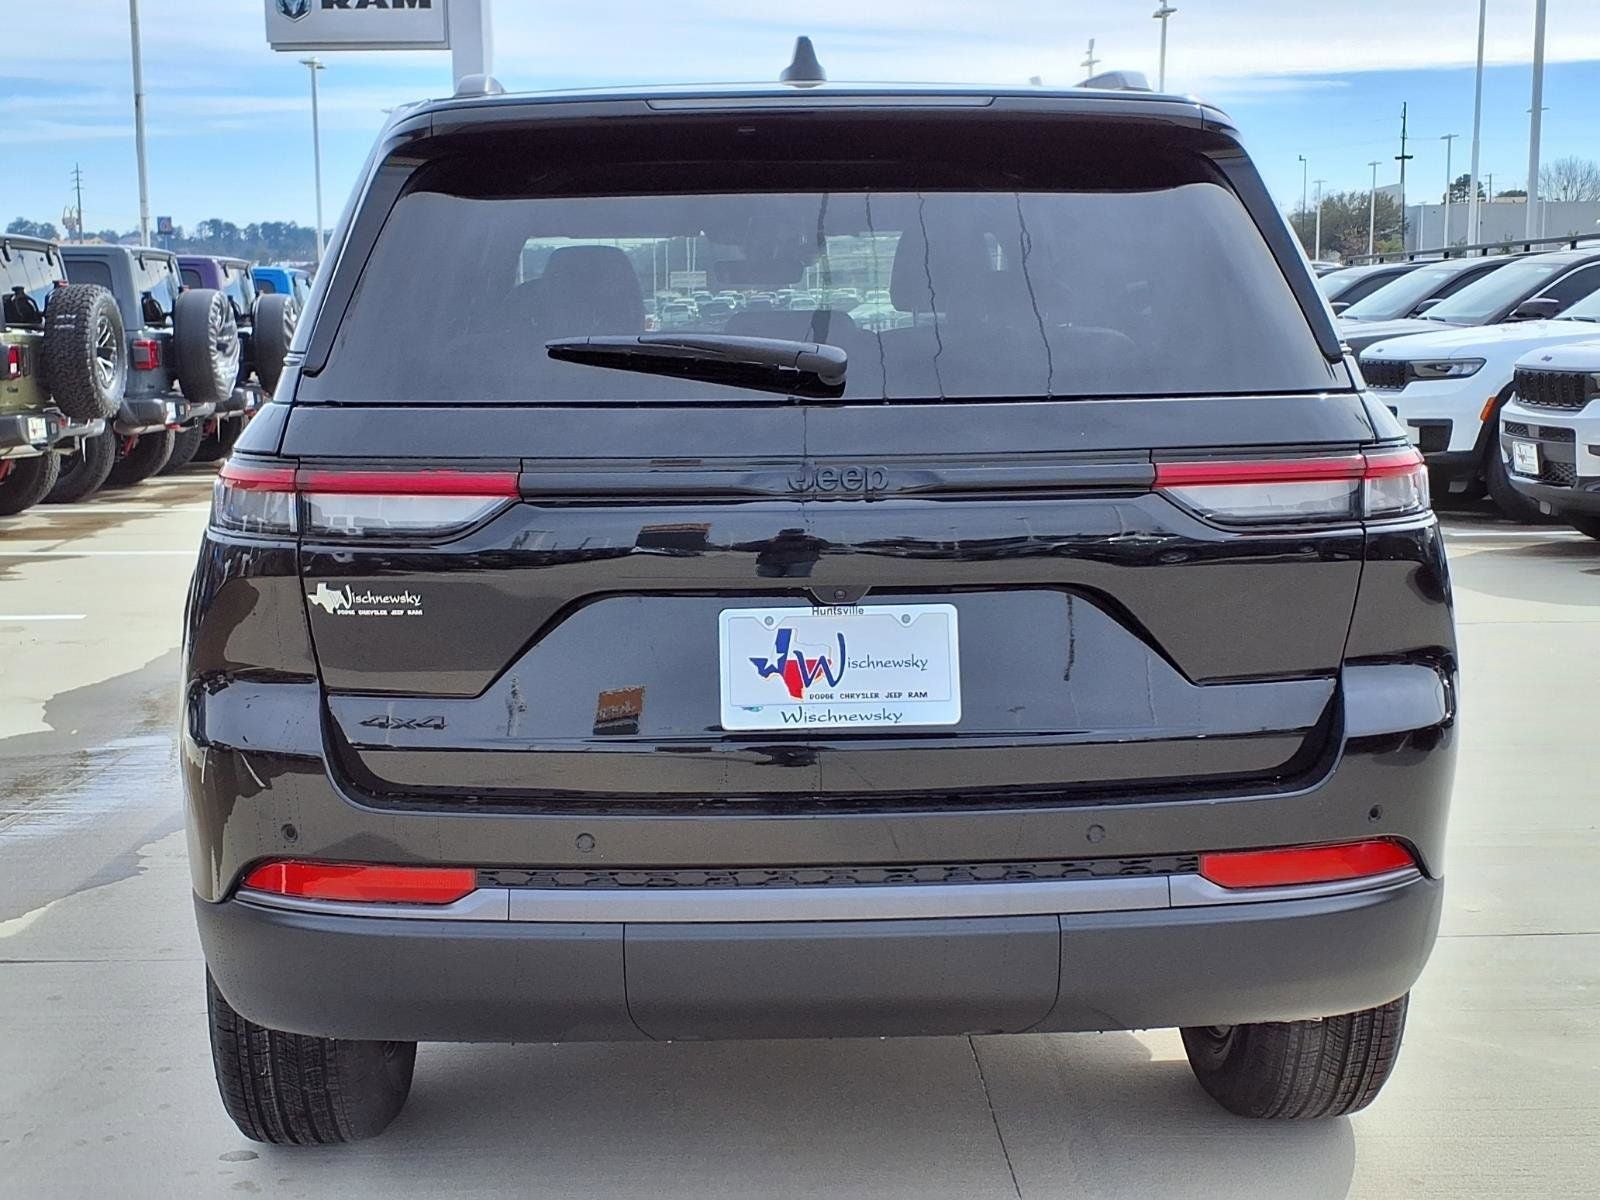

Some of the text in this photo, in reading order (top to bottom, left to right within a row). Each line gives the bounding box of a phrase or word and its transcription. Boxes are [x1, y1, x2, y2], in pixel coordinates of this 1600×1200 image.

[786, 463, 889, 499] Jeep
[811, 605, 865, 616] Huntsville
[793, 632, 928, 687] Wischnewsky
[885, 691, 902, 699] JEEP
[780, 706, 903, 724] Wischnewsky
